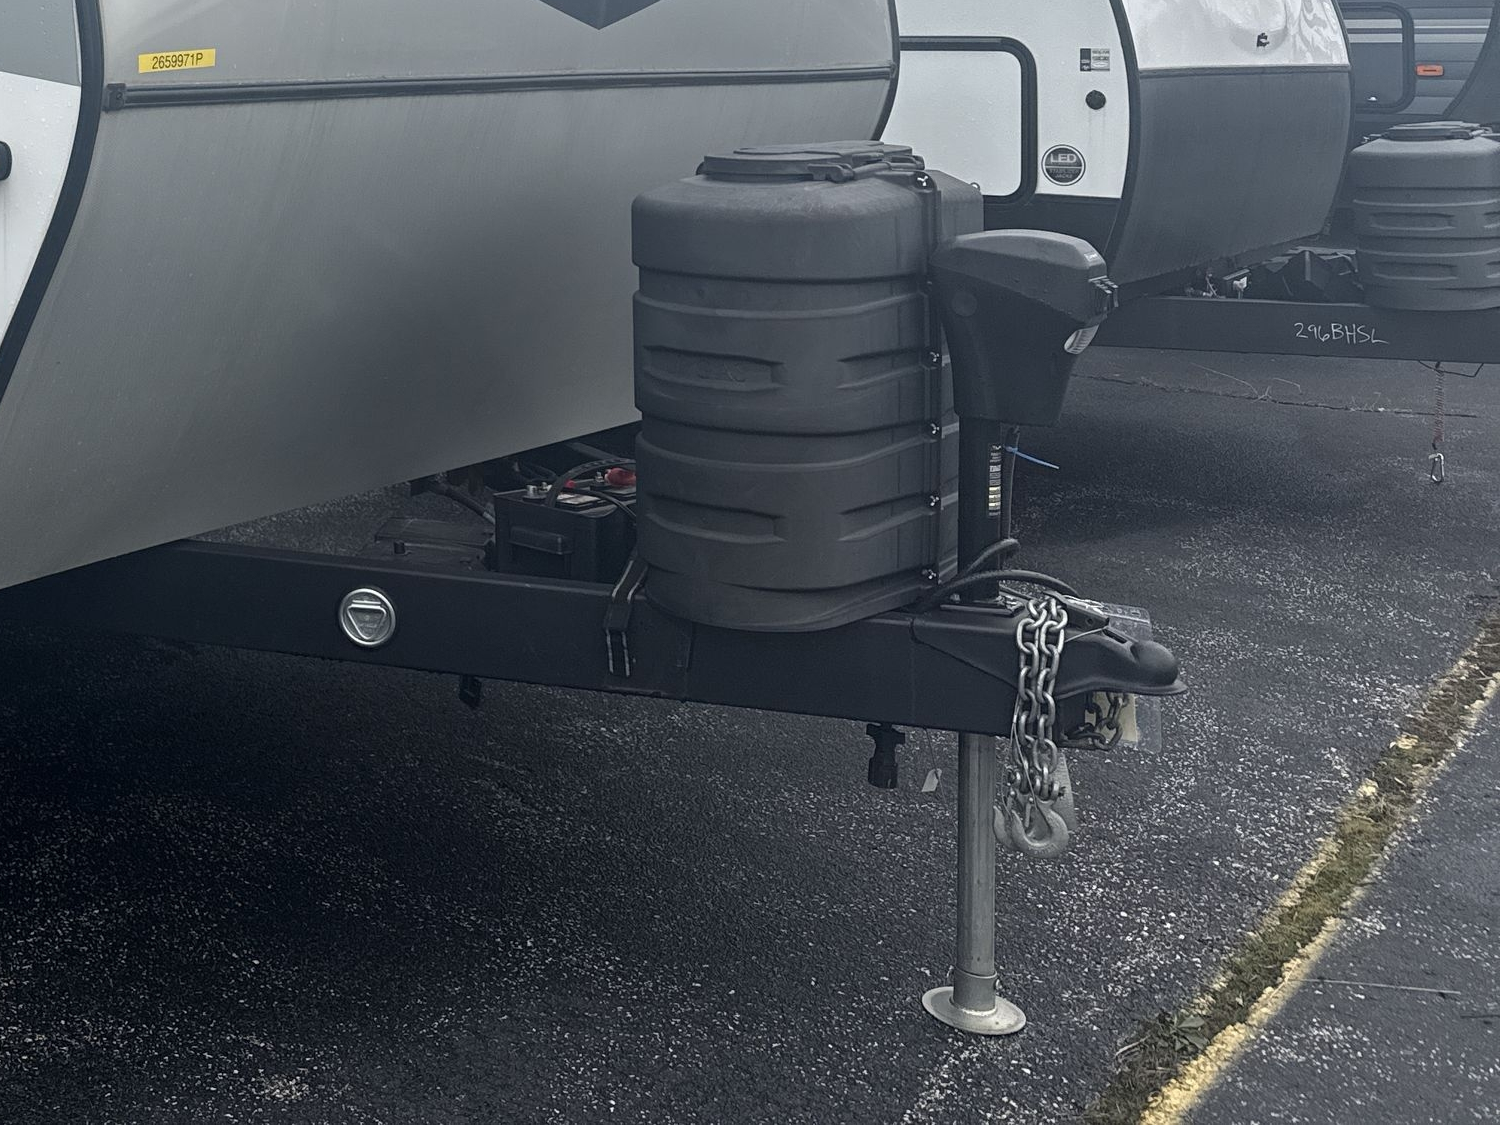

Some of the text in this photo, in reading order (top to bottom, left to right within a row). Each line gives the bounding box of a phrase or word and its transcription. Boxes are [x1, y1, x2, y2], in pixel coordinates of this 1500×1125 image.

[152, 52, 204, 70] 2659971P
[1050, 153, 1077, 164] LED
[1294, 322, 1390, 344] 296BHSL
